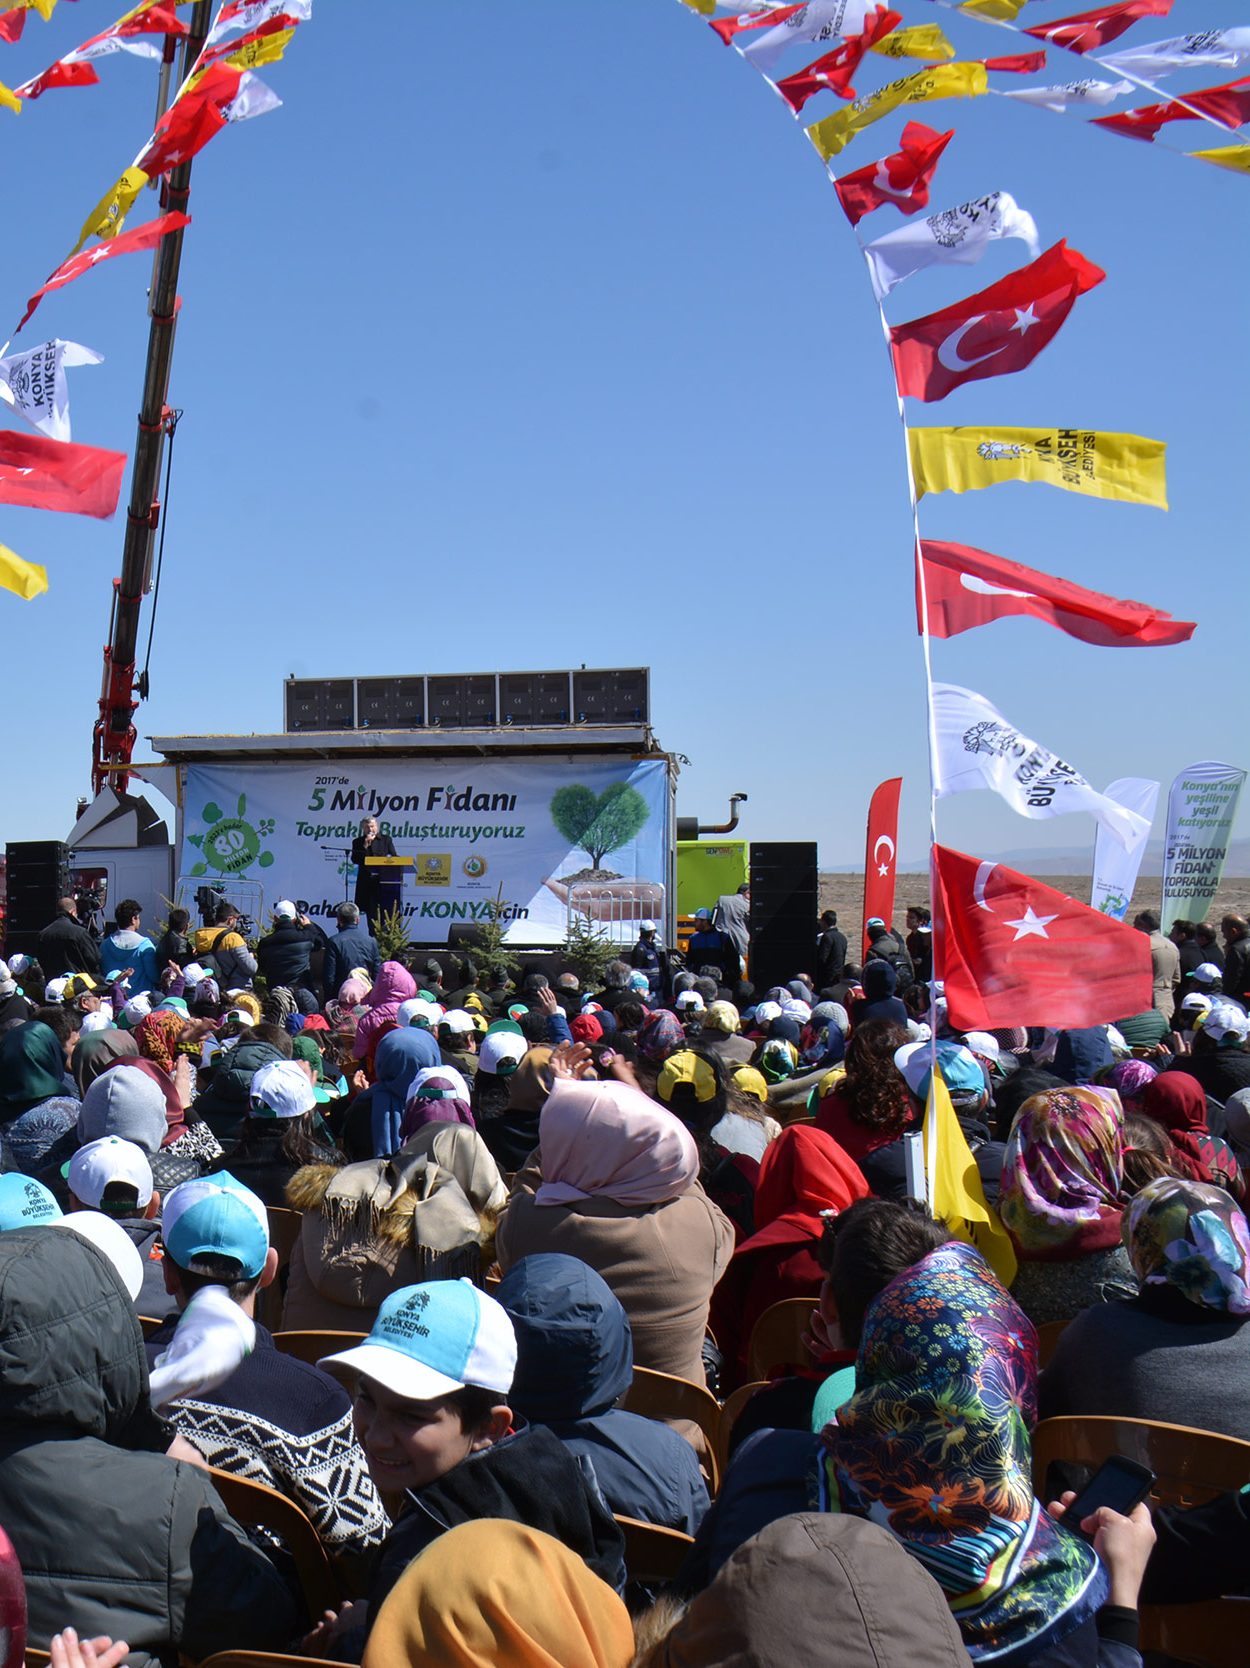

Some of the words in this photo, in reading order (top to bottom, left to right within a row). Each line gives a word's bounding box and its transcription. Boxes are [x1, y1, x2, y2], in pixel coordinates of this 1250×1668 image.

[31, 351, 45, 407] KONYA
[315, 776, 349, 785] 2017'de
[1181, 780, 1239, 793] Konya'nın
[308, 787, 326, 811] 5
[330, 784, 419, 818] Milyon
[426, 784, 517, 812] Fidanı
[1185, 793, 1230, 806] yeşiline
[1192, 805, 1219, 818] yeşil
[379, 820, 526, 843] Buluşturuyoruz
[1177, 817, 1232, 830] katıyoruz
[214, 829, 245, 856] 80
[223, 848, 250, 864] MİLYON
[1166, 848, 1175, 860] 5
[1178, 845, 1227, 861] MİLYON
[227, 854, 253, 872] FİDAN
[420, 901, 492, 919] KONYA
[396, 1309, 420, 1322] KONYA
